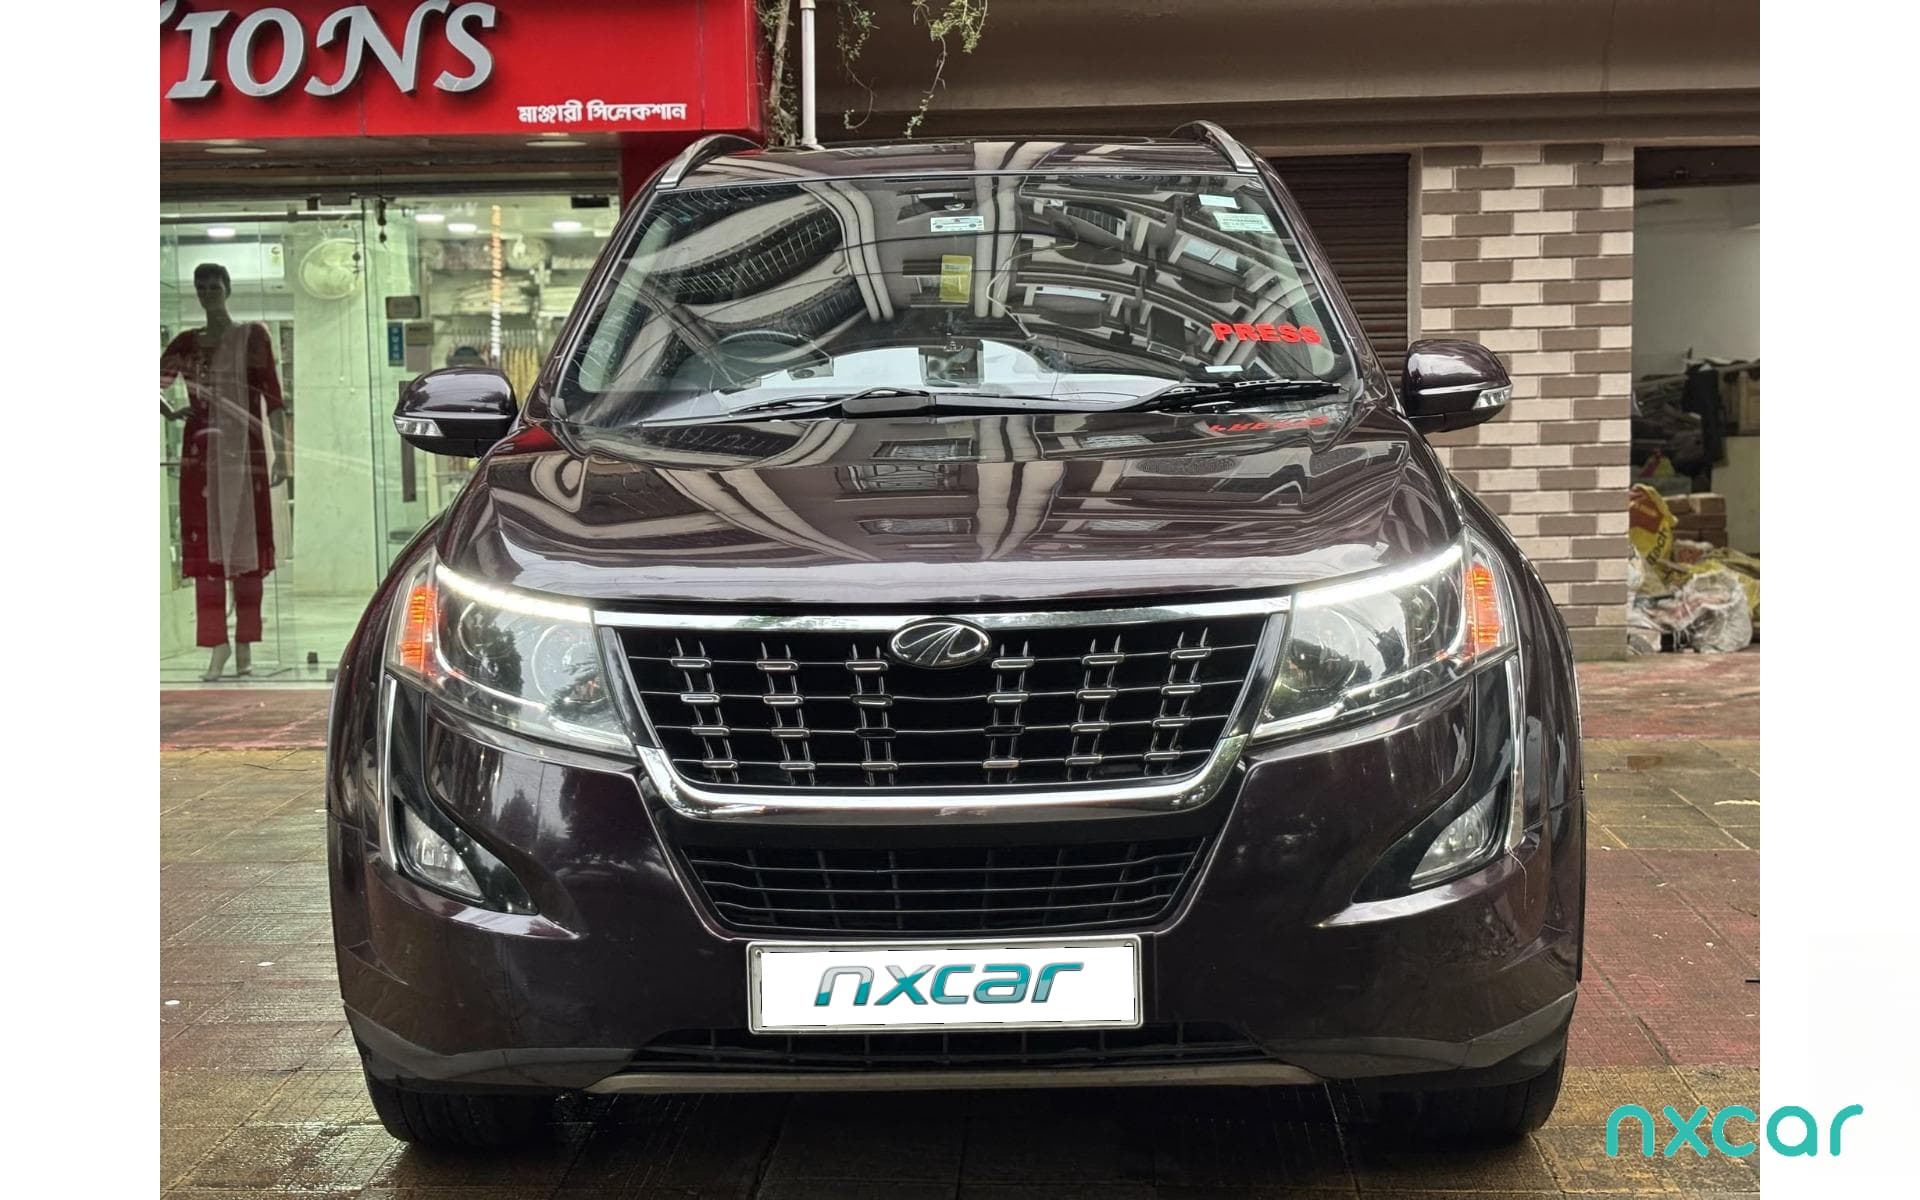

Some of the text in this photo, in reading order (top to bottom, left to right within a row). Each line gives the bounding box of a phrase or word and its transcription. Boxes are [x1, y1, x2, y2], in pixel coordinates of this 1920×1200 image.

[160, 0, 496, 100] IONS
[587, 99, 687, 122] সিলেকশান
[1211, 322, 1322, 345] PRESS
